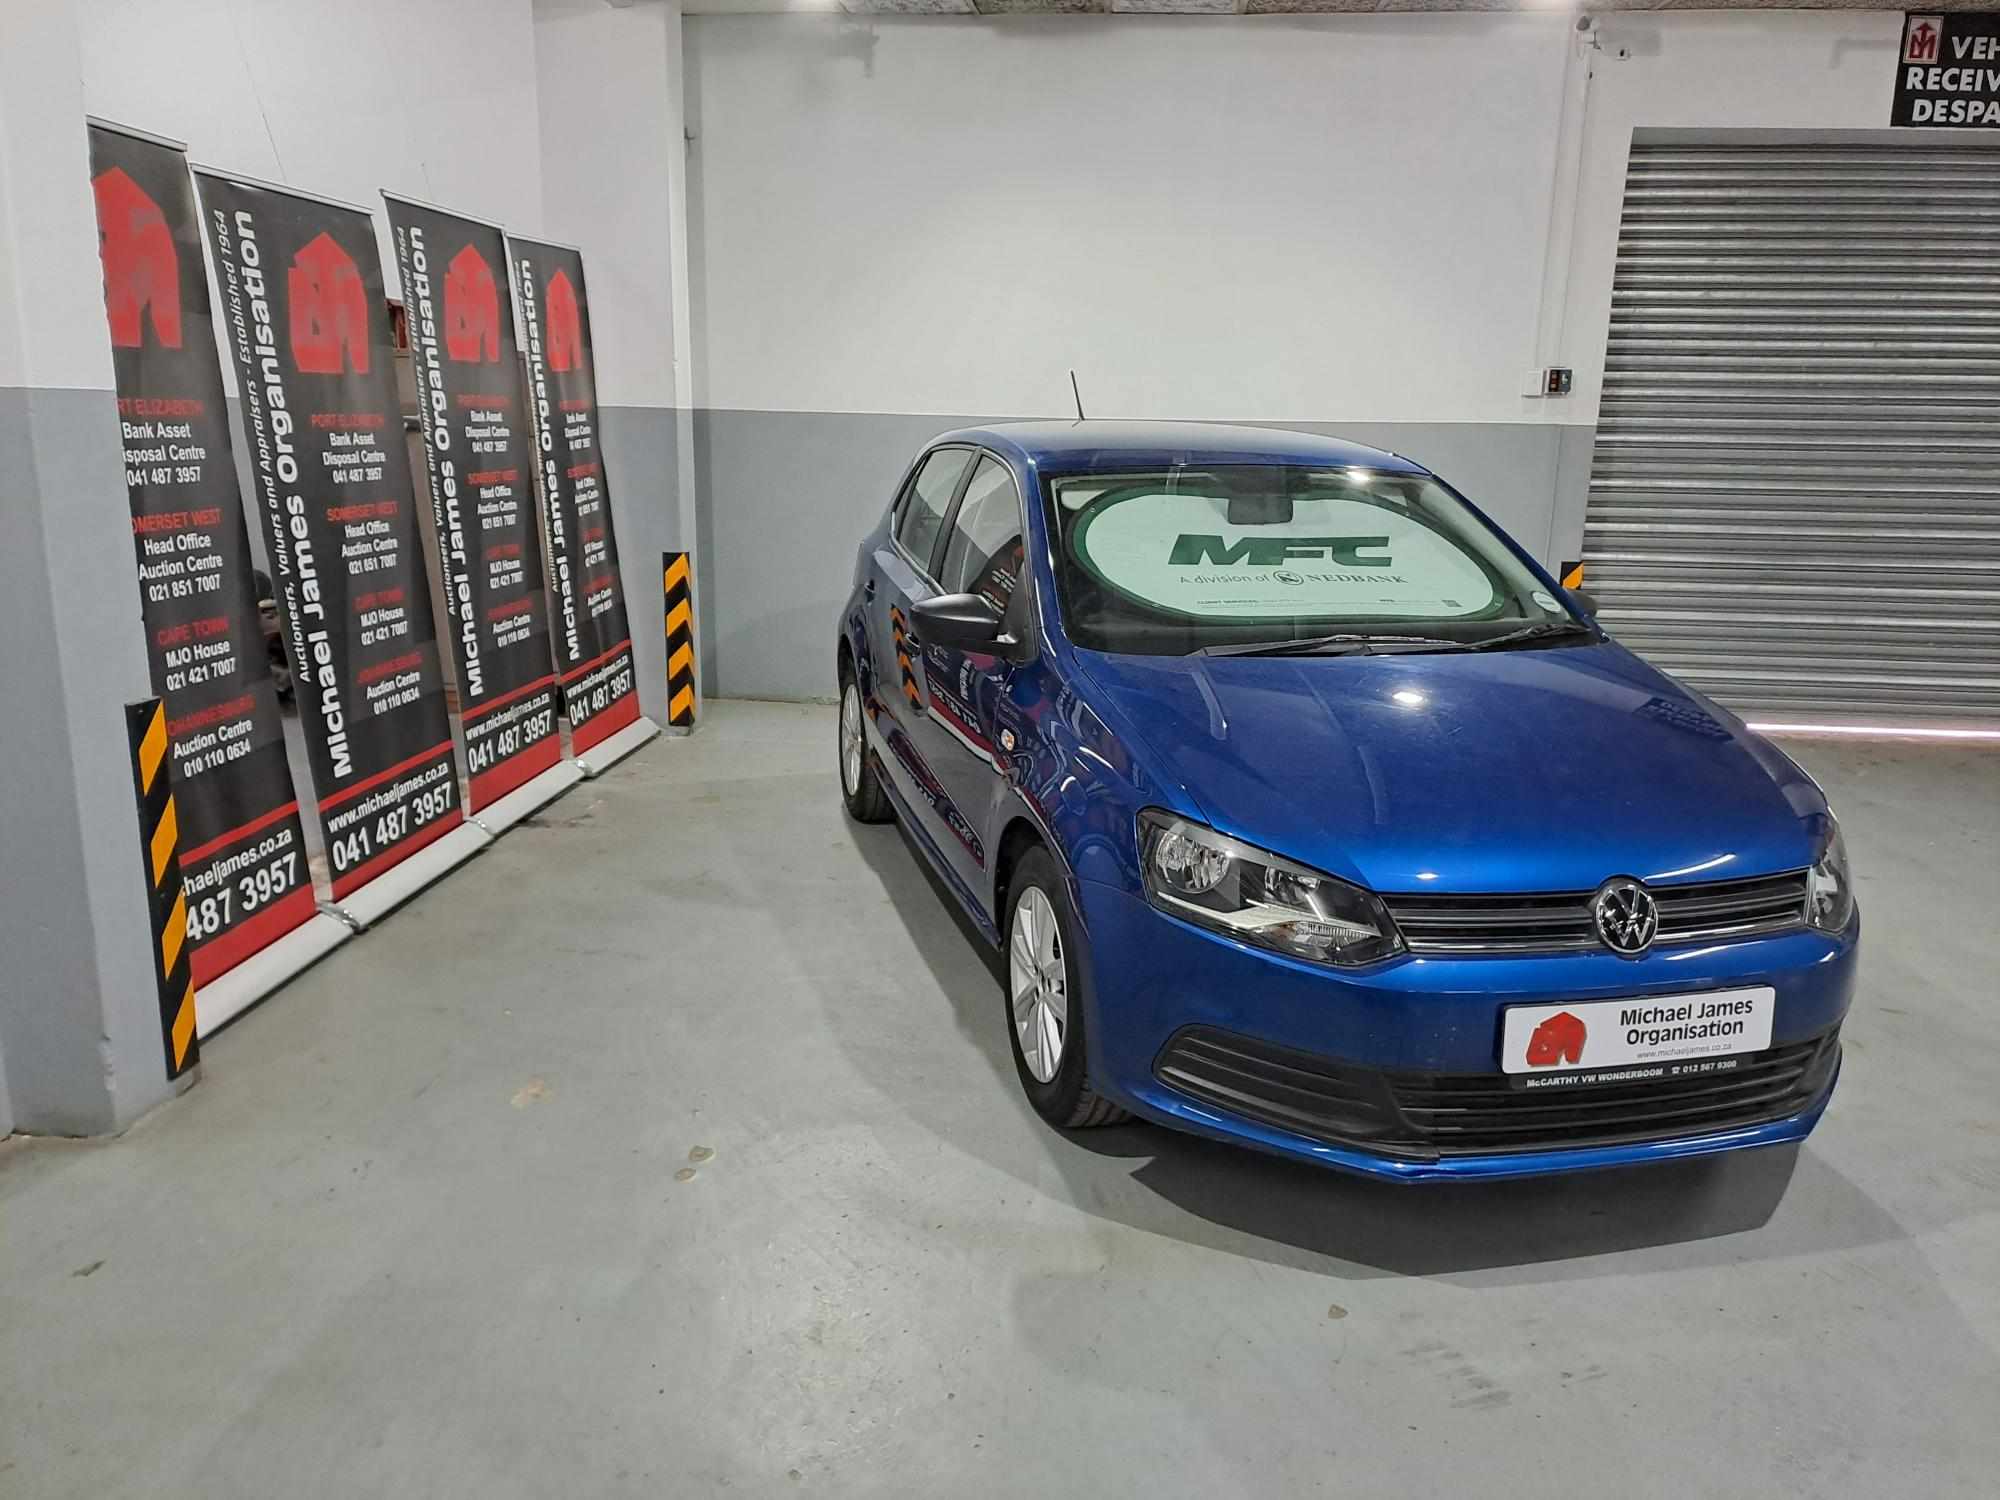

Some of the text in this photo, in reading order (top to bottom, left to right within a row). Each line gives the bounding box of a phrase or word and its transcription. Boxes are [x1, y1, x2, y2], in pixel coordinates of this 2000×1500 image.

[1911, 98, 2000, 124] DESPA
[213, 210, 230, 259] 1964
[221, 259, 252, 364] Established
[122, 421, 191, 439] Bank Asset
[246, 379, 272, 472] Appraisers
[329, 432, 352, 446] Bank
[169, 444, 206, 460] Centre
[323, 452, 360, 467] Disposal
[410, 227, 484, 697] Michael James Organisation
[127, 466, 200, 487] 041 487 3957
[261, 474, 278, 509] and
[234, 210, 352, 779] Michael James Organisation
[546, 459, 565, 549] James
[144, 533, 212, 556] Head Office
[271, 513, 290, 575] Valuers
[342, 543, 372, 558] Auction
[1168, 534, 1392, 567] MFC
[140, 554, 223, 580] Auction Centre
[1180, 573, 1409, 585] A division of NEDBANK
[149, 574, 221, 602] 021 851 7007
[378, 607, 404, 622] House
[556, 556, 580, 661] Michael
[283, 581, 311, 682] Auctioneers,
[166, 640, 230, 668] MJO House
[166, 657, 236, 691] 021 421 7007
[367, 680, 396, 700] Auction
[569, 669, 631, 726] 041 487 3957
[174, 719, 253, 759] Auction Centre
[468, 709, 551, 773] 041 487 3957
[184, 758, 204, 777] 010
[205, 749, 225, 768] 110
[327, 762, 449, 834] www.michaeljames.co.za
[332, 781, 451, 871] 041 487 3957
[186, 851, 297, 941] 487 3957
[1620, 1000, 1753, 1026] Michael James
[1626, 1018, 1744, 1046] Organisation
